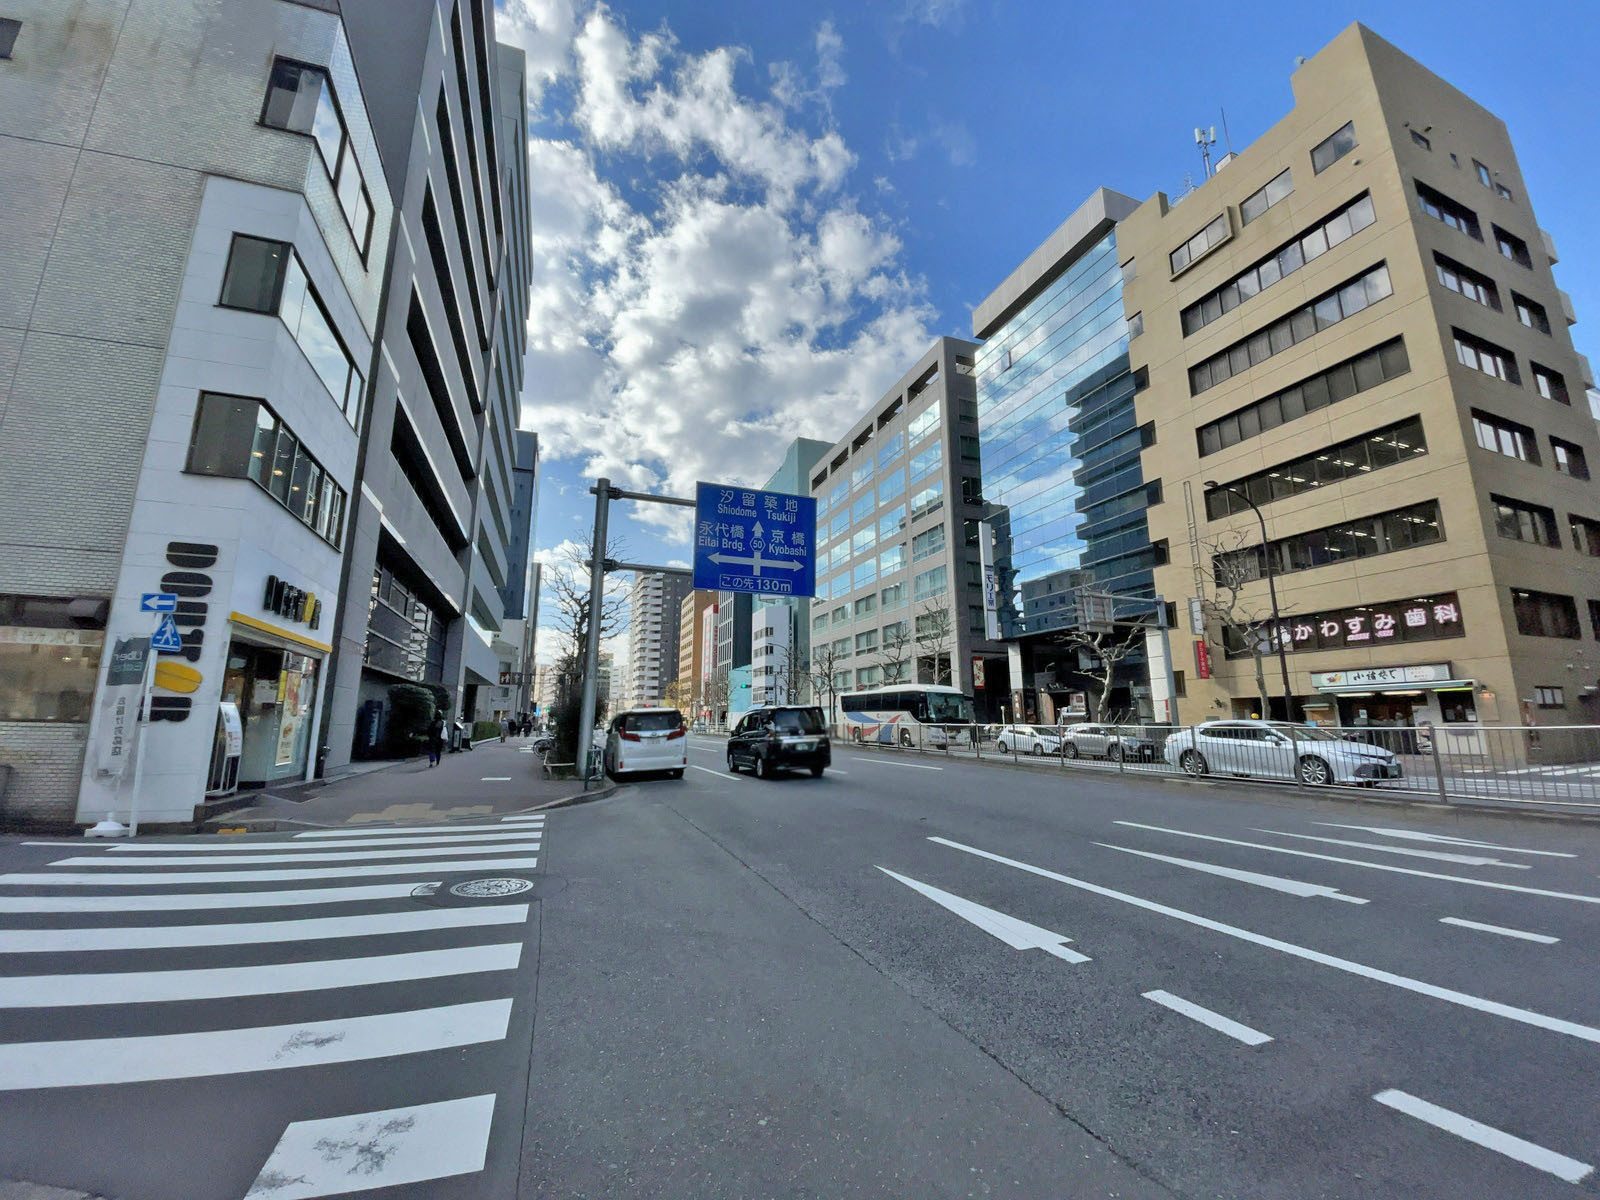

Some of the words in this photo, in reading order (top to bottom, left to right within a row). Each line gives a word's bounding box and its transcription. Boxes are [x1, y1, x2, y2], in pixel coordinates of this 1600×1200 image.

[717, 503, 757, 518] Shiodome
[766, 509, 796, 525] Tsukiji
[699, 521, 745, 540] 永代橋
[771, 529, 805, 546] 京橋
[698, 535, 719, 548] Eitai
[722, 539, 746, 552] Brdg.
[752, 540, 762, 549] 50
[768, 543, 807, 557] Kyobashi
[1294, 603, 1459, 641] かわすみ歯科
